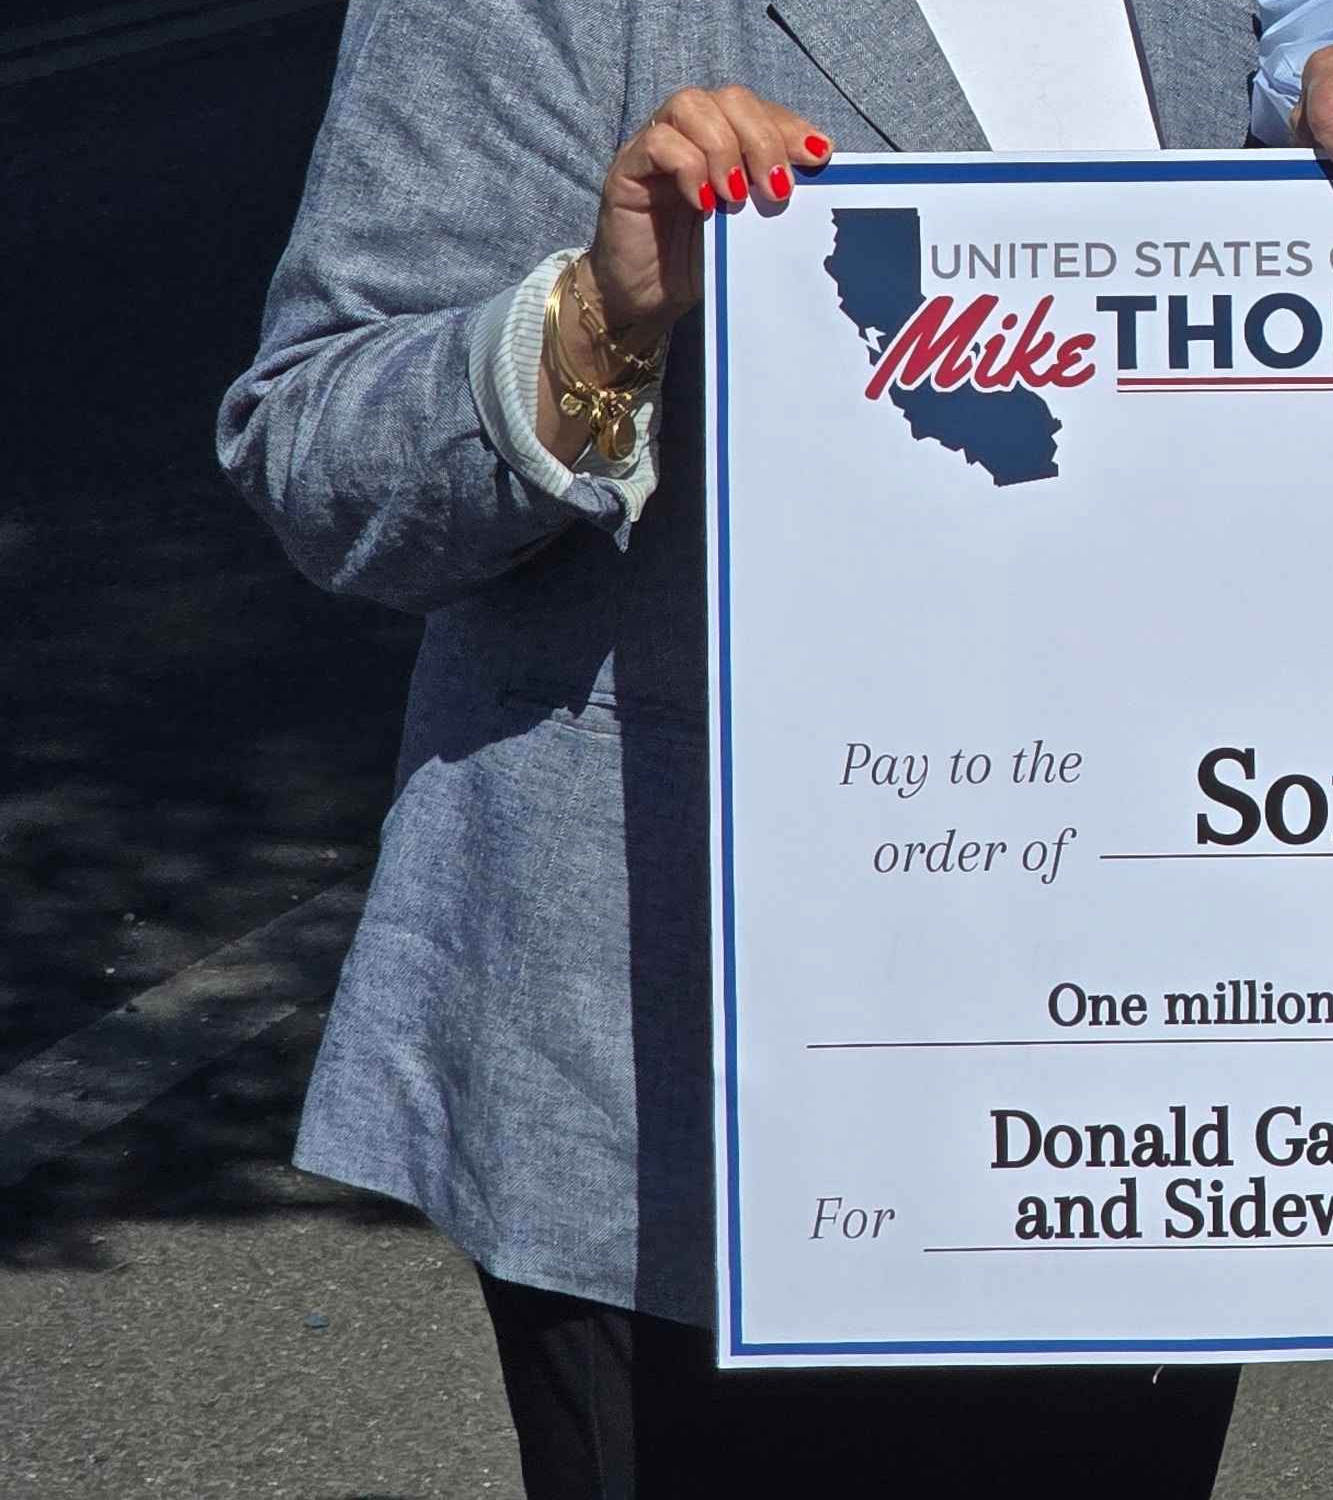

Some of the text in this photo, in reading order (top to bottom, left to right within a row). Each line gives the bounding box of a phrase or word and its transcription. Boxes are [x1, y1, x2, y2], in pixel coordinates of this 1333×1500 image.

[931, 241, 1118, 280] UNITED
[1134, 239, 1313, 279] STATES
[864, 294, 1098, 402] Mike
[839, 739, 1083, 799] Pay to the
[873, 826, 1078, 886] order of
[1047, 982, 1148, 1028] One
[989, 1104, 1235, 1170] Donald
[808, 1196, 897, 1243] For
[1014, 1176, 1143, 1241] and
